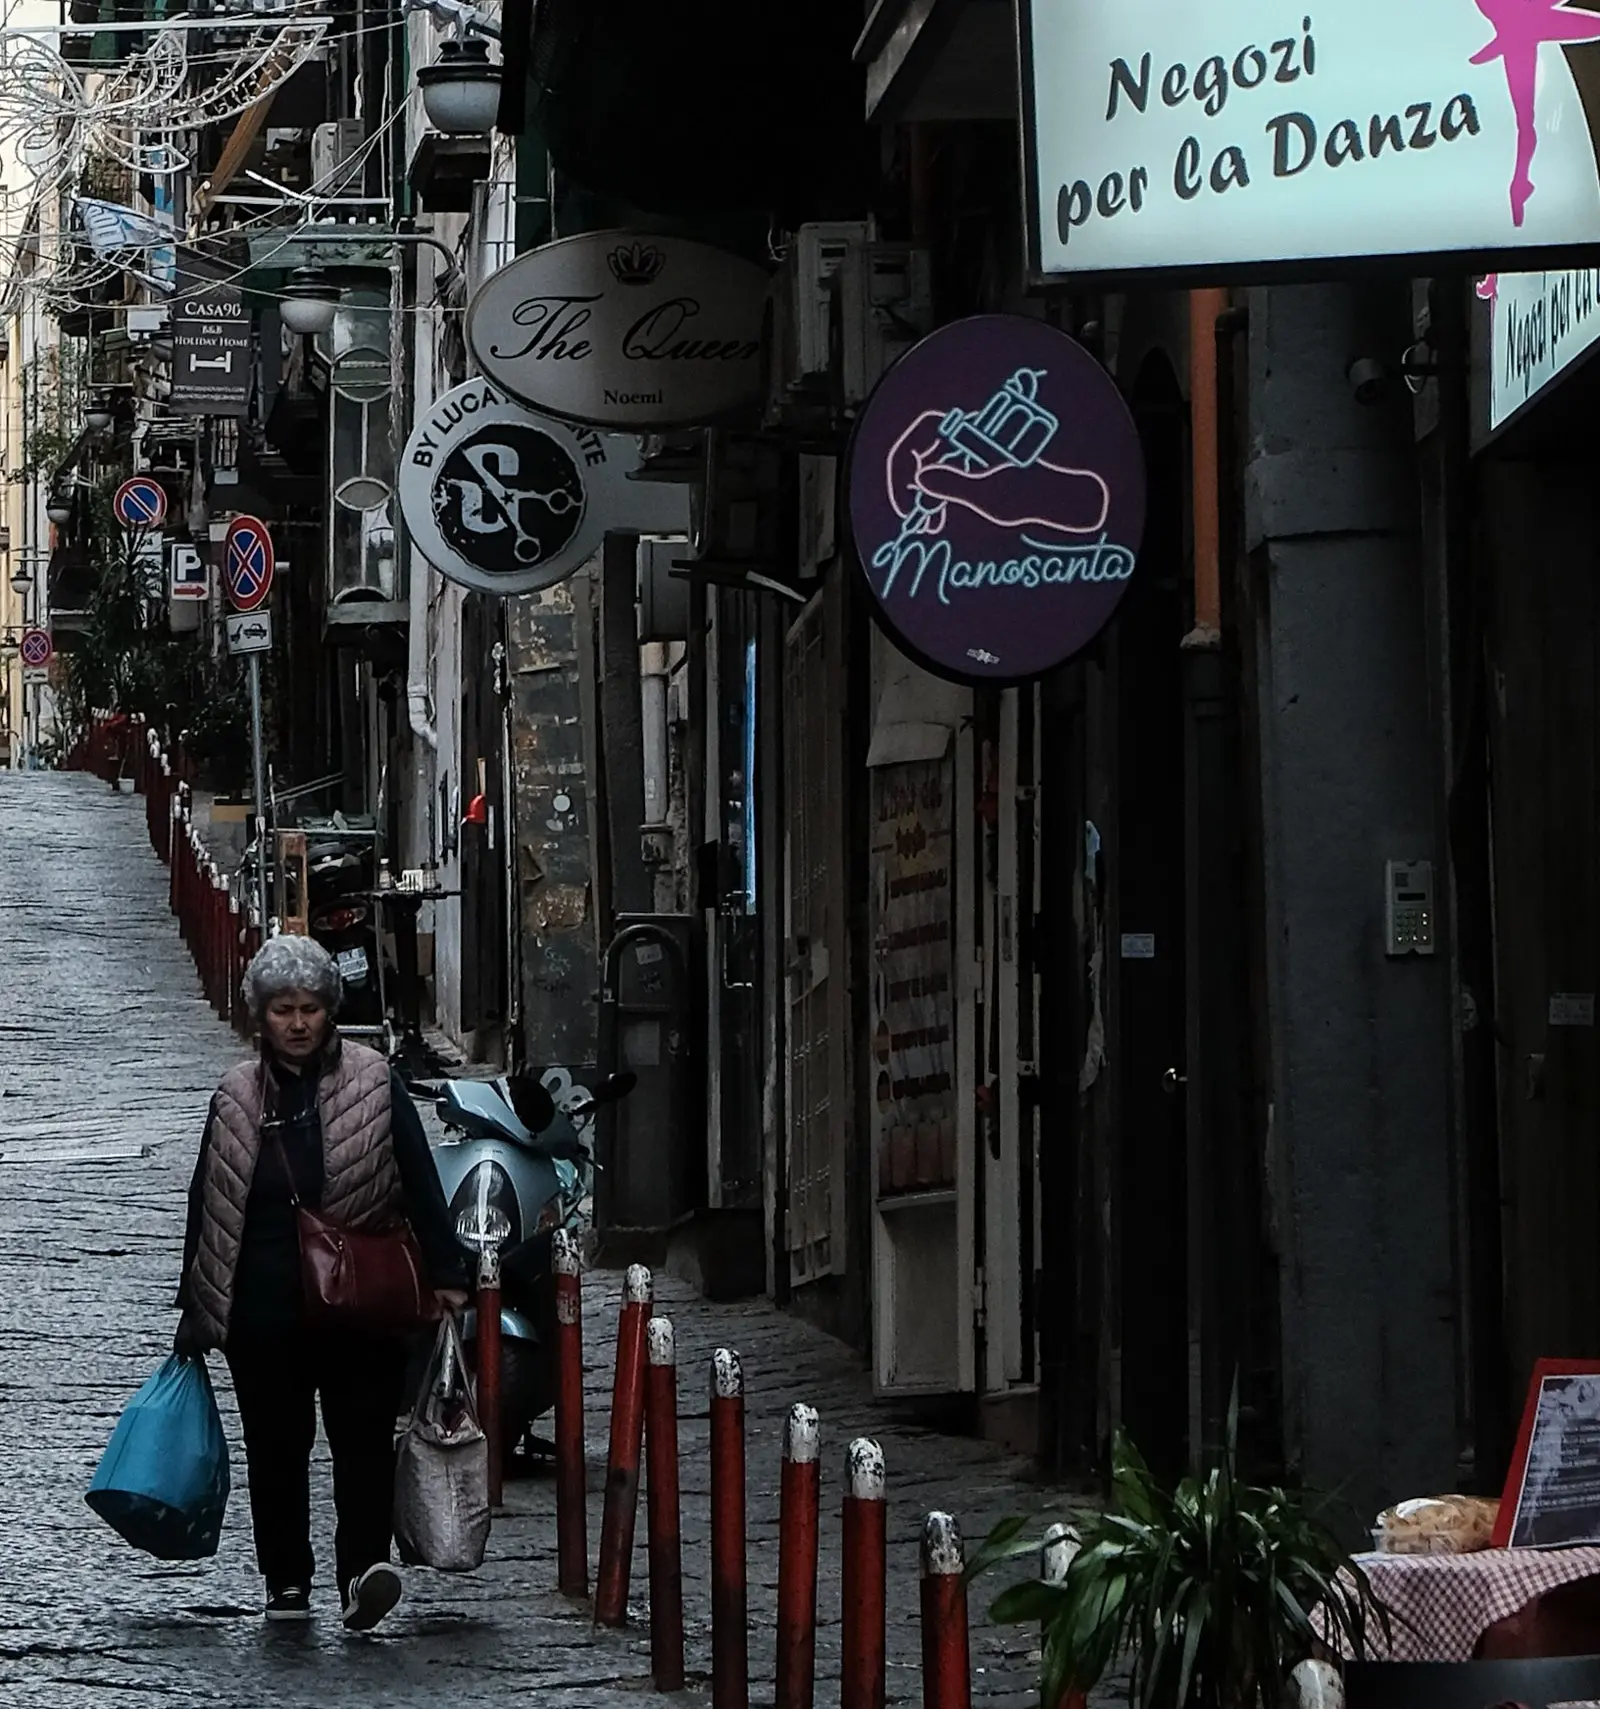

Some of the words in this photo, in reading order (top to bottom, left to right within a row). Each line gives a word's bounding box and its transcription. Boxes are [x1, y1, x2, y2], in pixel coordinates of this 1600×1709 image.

[1105, 15, 1316, 121] Negozi
[1056, 165, 1148, 245] per
[1173, 135, 1250, 200] la
[1265, 93, 1481, 178] Danza
[174, 335, 218, 347] HOLIDAY
[219, 337, 249, 348] HOME
[184, 301, 242, 318] CASA90
[489, 293, 604, 361] The
[413, 431, 438, 468] BY
[432, 386, 499, 435] LUCA
[603, 388, 663, 405] Noemi
[176, 548, 202, 581] P
[872, 532, 1137, 605] Manosanta
